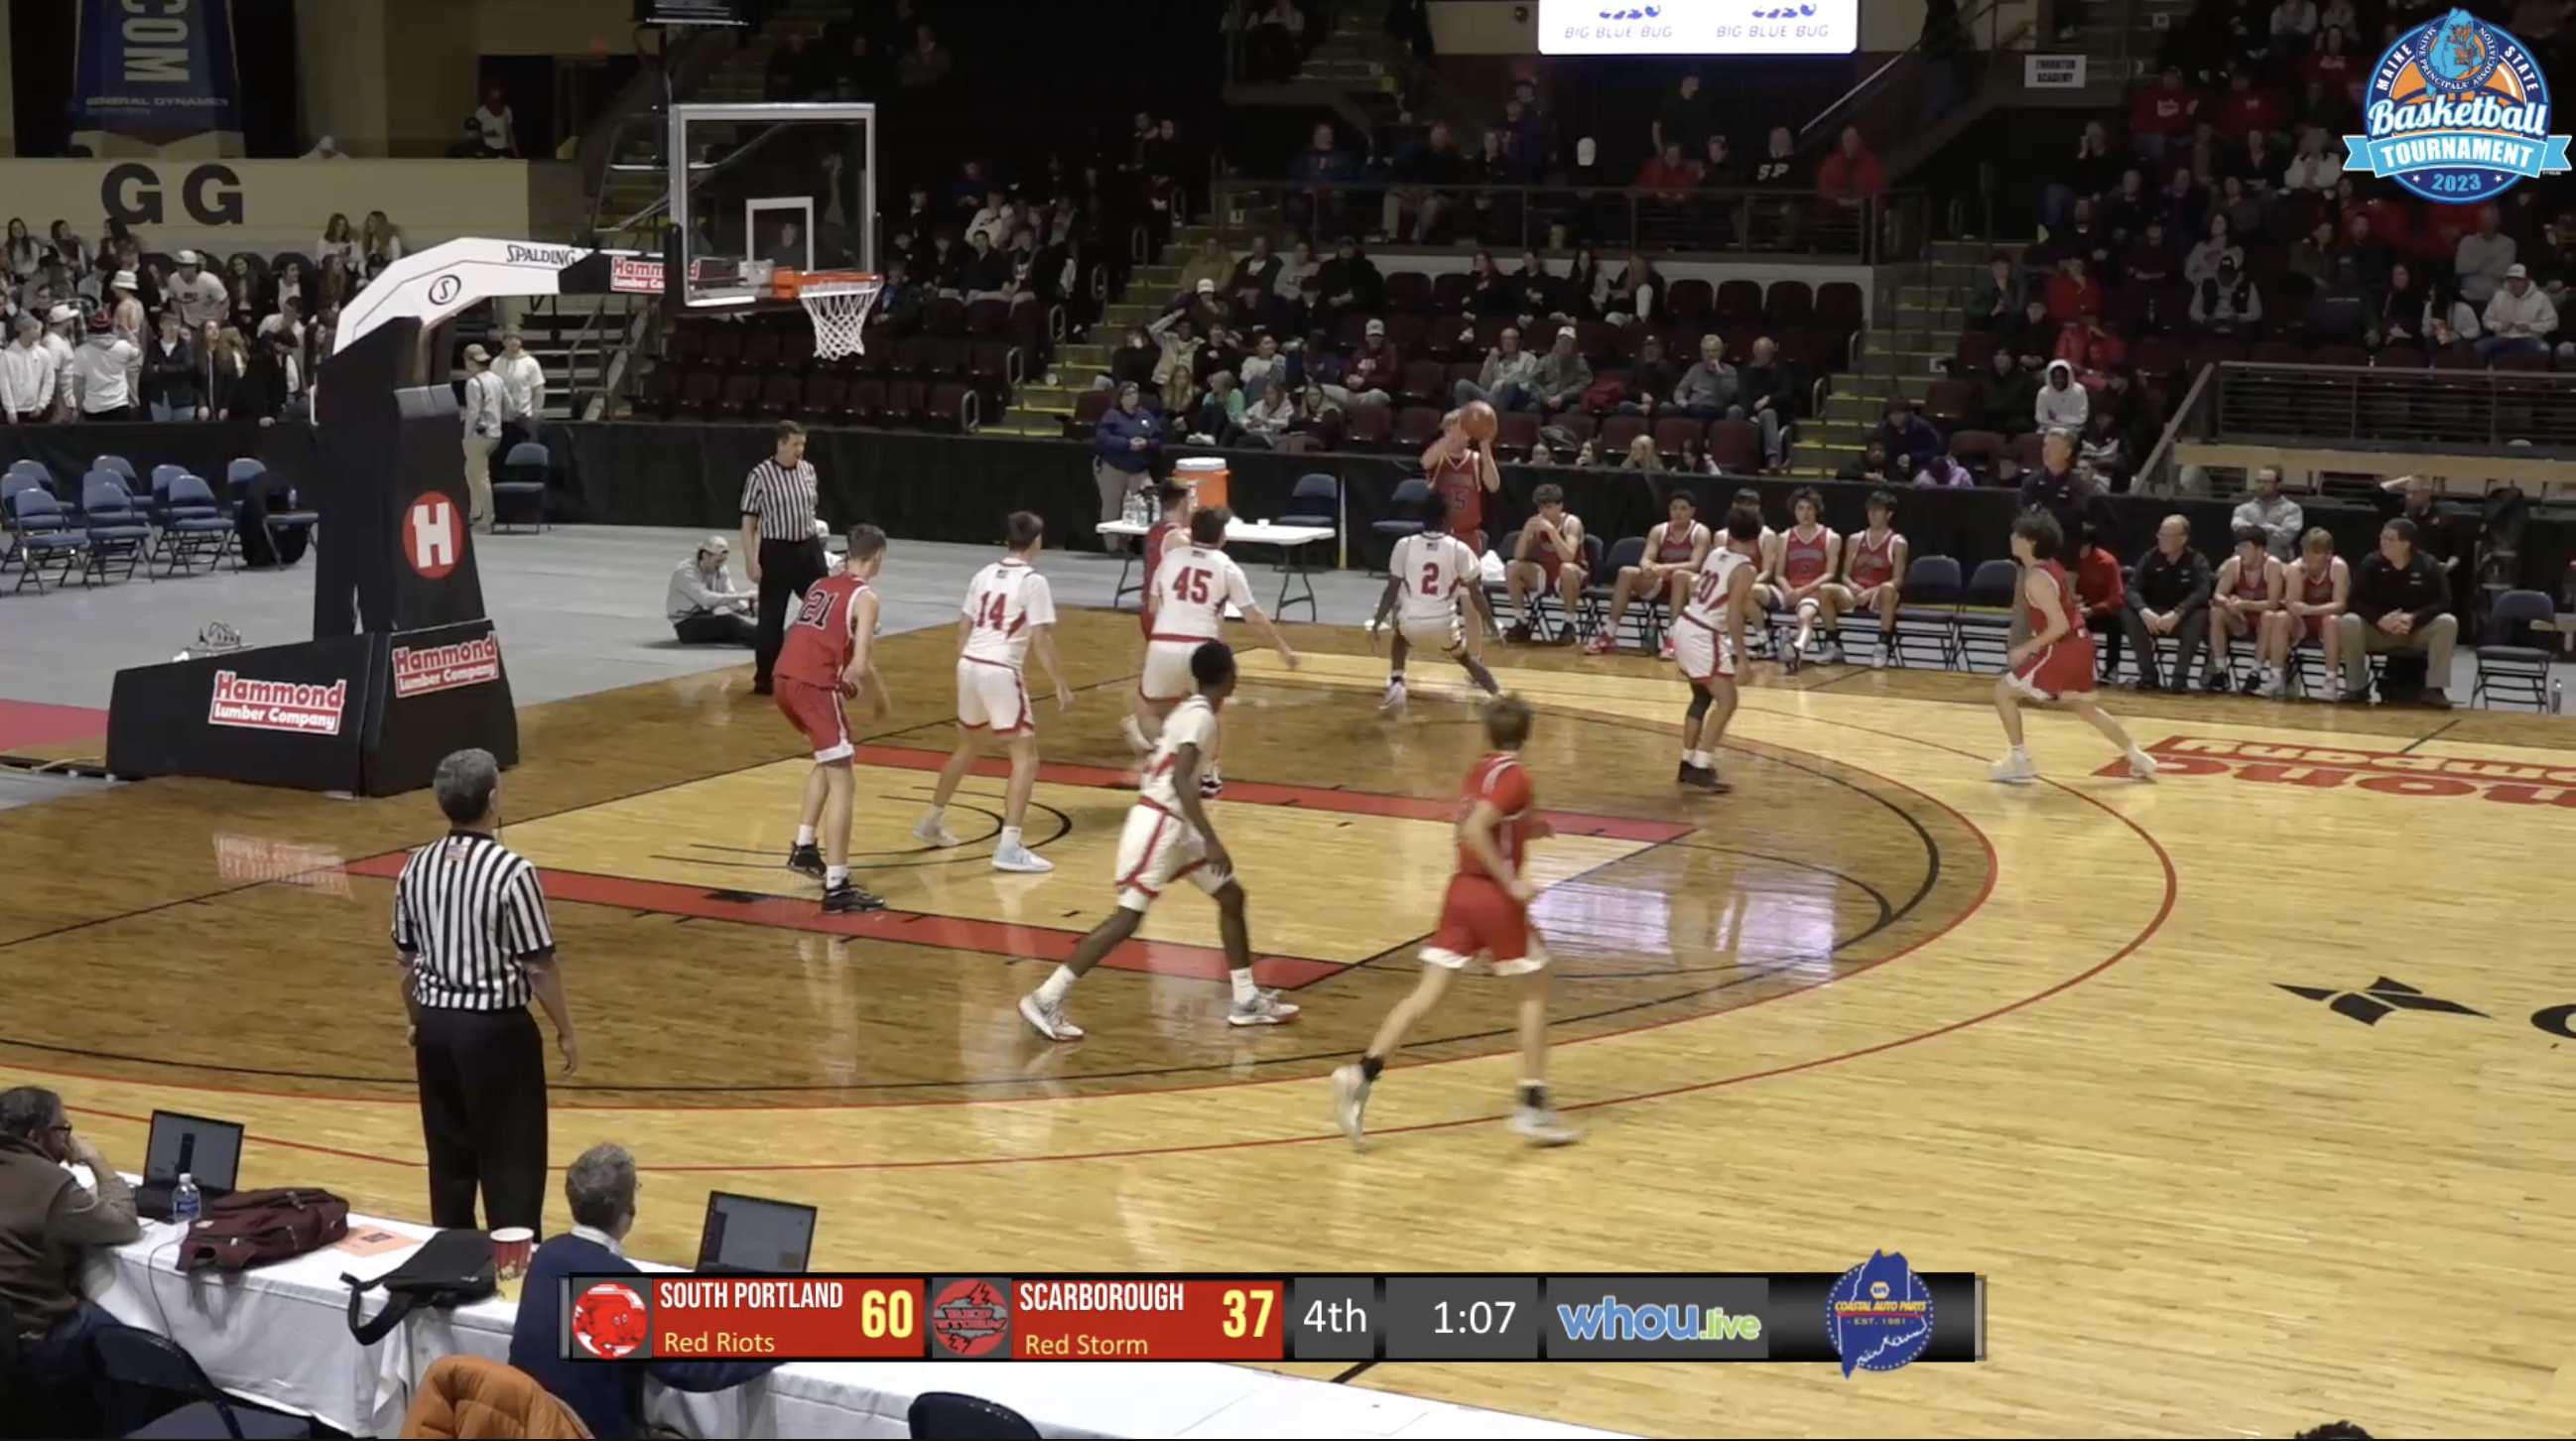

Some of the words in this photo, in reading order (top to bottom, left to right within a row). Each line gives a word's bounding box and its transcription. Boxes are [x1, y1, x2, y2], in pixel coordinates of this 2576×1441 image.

[1564, 26, 1590, 39] BIG
[1596, 26, 1632, 39] BLUE
[1640, 26, 1673, 39] BUG
[1717, 26, 1742, 38] BIG
[1748, 25, 1789, 38] BLUE
[1795, 25, 1829, 38] BUG
[507, 244, 577, 266] SPALDING
[412, 501, 453, 569] H
[1173, 567, 1213, 604] 45
[1421, 562, 1439, 595] 2
[797, 589, 838, 629] 21
[976, 591, 1007, 631] 14
[393, 632, 496, 673] Hammond
[215, 671, 346, 708] Hammond
[399, 675, 442, 692] Lumber
[443, 662, 496, 683] Company
[214, 704, 266, 722] Lumber
[268, 707, 336, 731] Company
